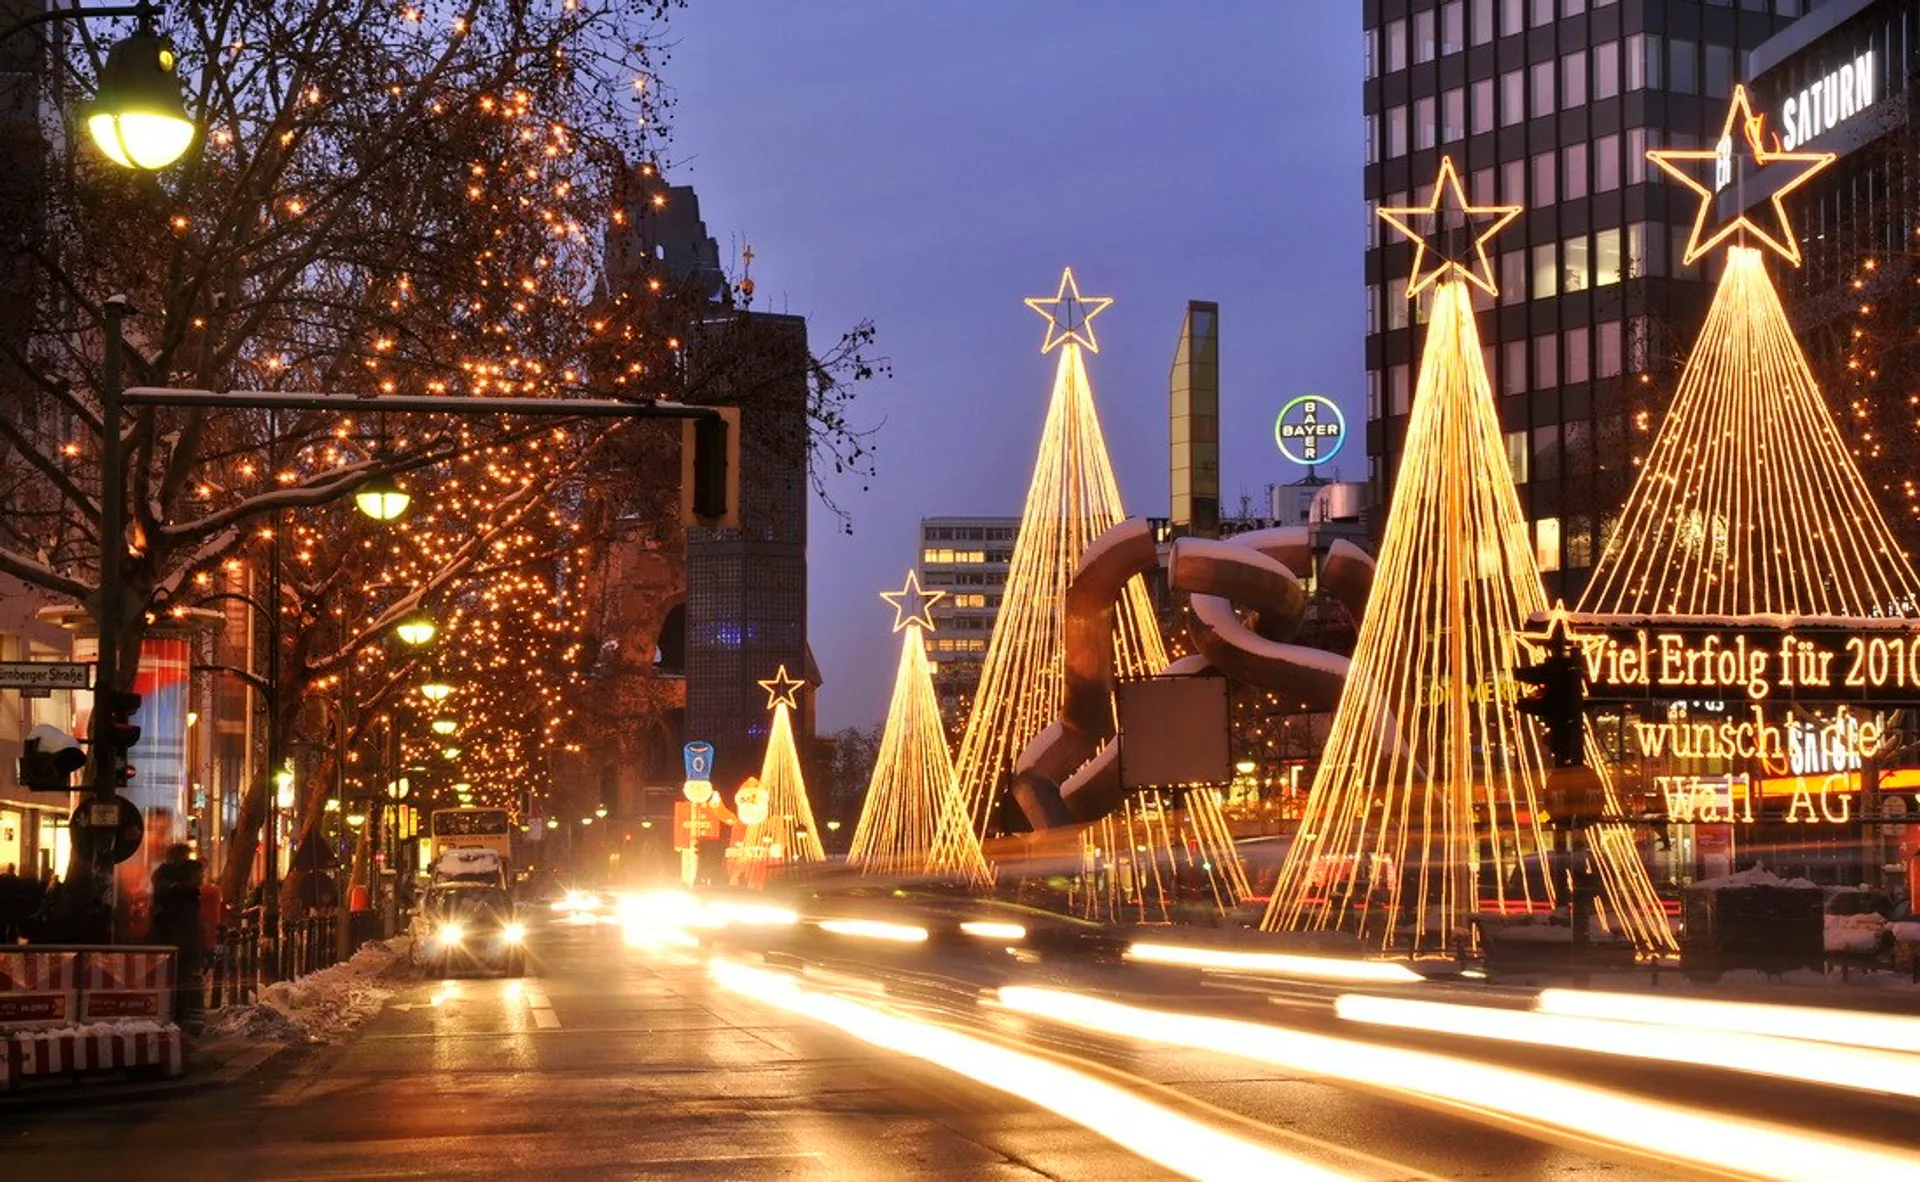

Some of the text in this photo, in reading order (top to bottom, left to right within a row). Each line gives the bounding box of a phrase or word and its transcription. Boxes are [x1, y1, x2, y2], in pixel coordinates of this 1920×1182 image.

[1783, 51, 1874, 151] SATURN
[1282, 424, 1338, 437] BAYER
[1304, 402, 1316, 459] BAYER
[49, 668, 83, 683] Straße
[1580, 631, 1920, 699] Viel Erfolg für 2010
[1634, 704, 1879, 759] wünscht die
[1654, 772, 1852, 823] Wall AG
